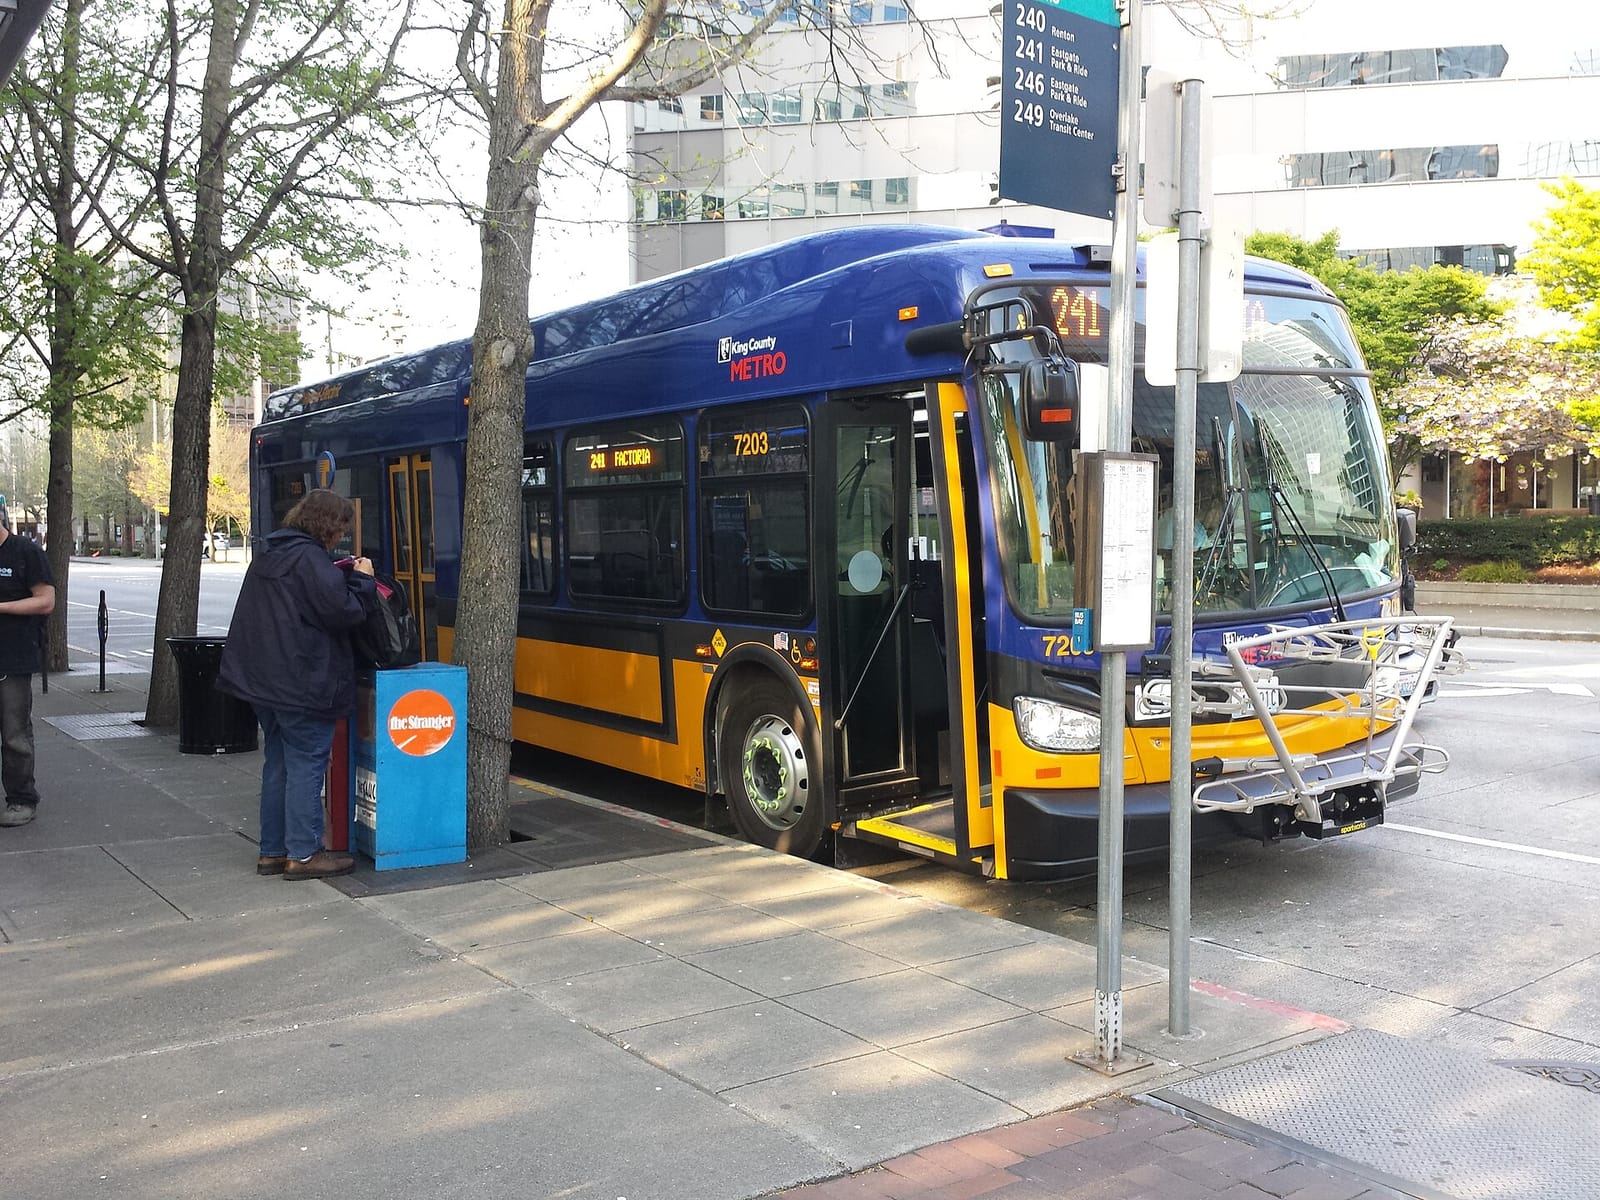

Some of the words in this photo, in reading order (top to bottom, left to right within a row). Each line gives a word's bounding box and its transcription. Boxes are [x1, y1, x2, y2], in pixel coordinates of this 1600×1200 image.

[1016, 3, 1046, 33] 240
[1051, 26, 1075, 43] Renton
[1015, 35, 1043, 64] 241
[1051, 46, 1080, 63] Eastgate
[1051, 57, 1066, 72] Park
[1066, 63, 1073, 73] &
[1073, 64, 1088, 78] Ride
[1014, 67, 1045, 96] 246
[1050, 77, 1079, 95] Eastgate
[1050, 89, 1065, 102] Park
[1066, 93, 1072, 104] &
[1073, 95, 1088, 108] Ride
[1014, 99, 1044, 127] 249
[1049, 108, 1079, 126] Overlake
[1049, 120, 1072, 136] Transit
[1072, 126, 1095, 140] Center
[1052, 288, 1102, 337] 241
[732, 341, 749, 356] King
[749, 335, 777, 351] County
[730, 351, 787, 382] METRO
[733, 431, 769, 456] 7203
[590, 453, 606, 469] 241
[614, 448, 651, 467] FACTORIA
[1042, 635, 1094, 656] 72
[390, 716, 408, 730] the
[408, 714, 454, 731] Stranger
